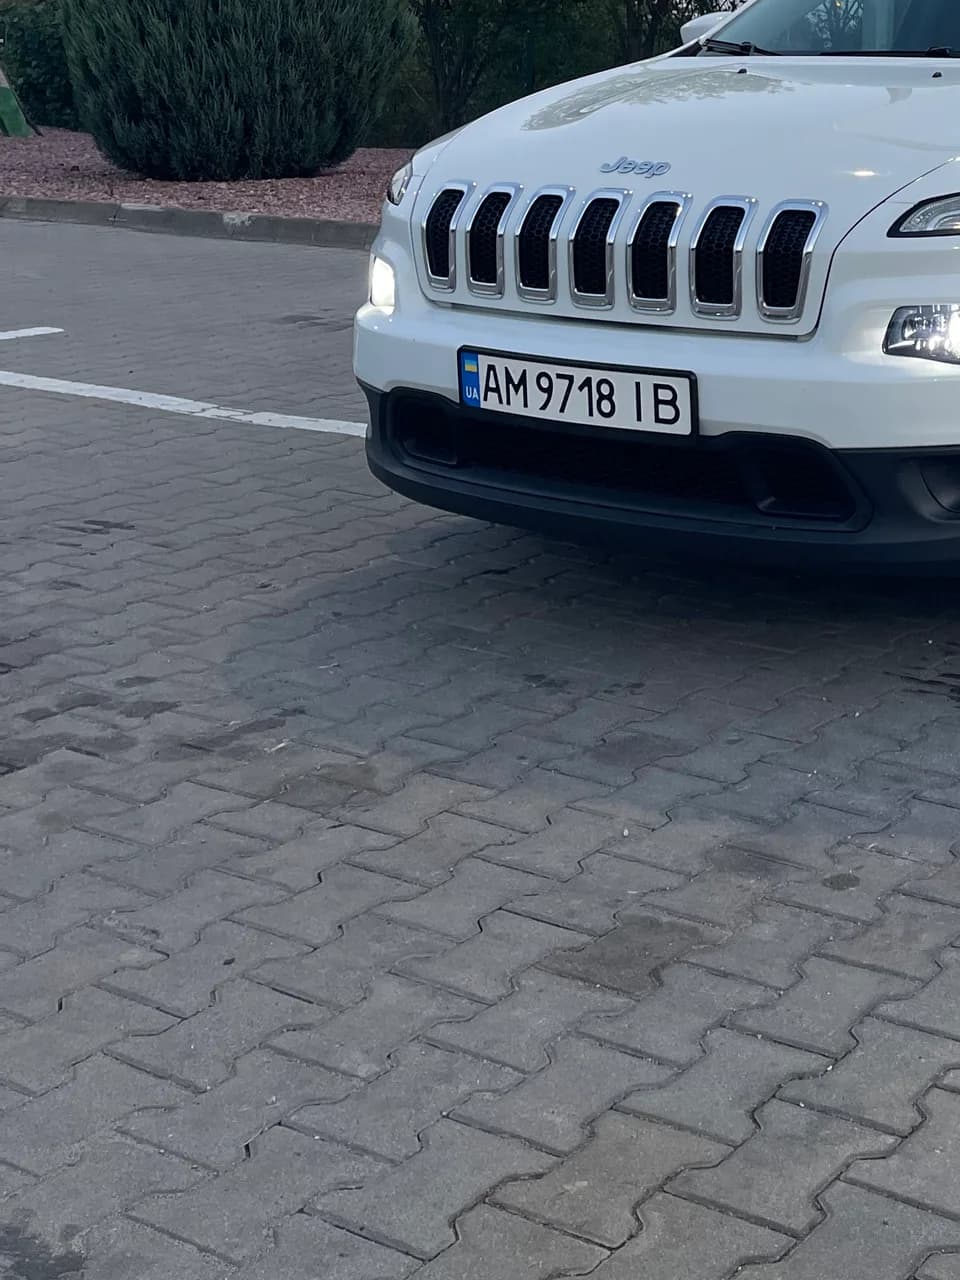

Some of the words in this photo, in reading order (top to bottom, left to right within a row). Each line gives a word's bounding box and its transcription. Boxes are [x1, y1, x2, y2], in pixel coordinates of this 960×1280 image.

[600, 156, 671, 179] Jeep
[465, 385, 479, 400] UA
[635, 381, 681, 425] IB
